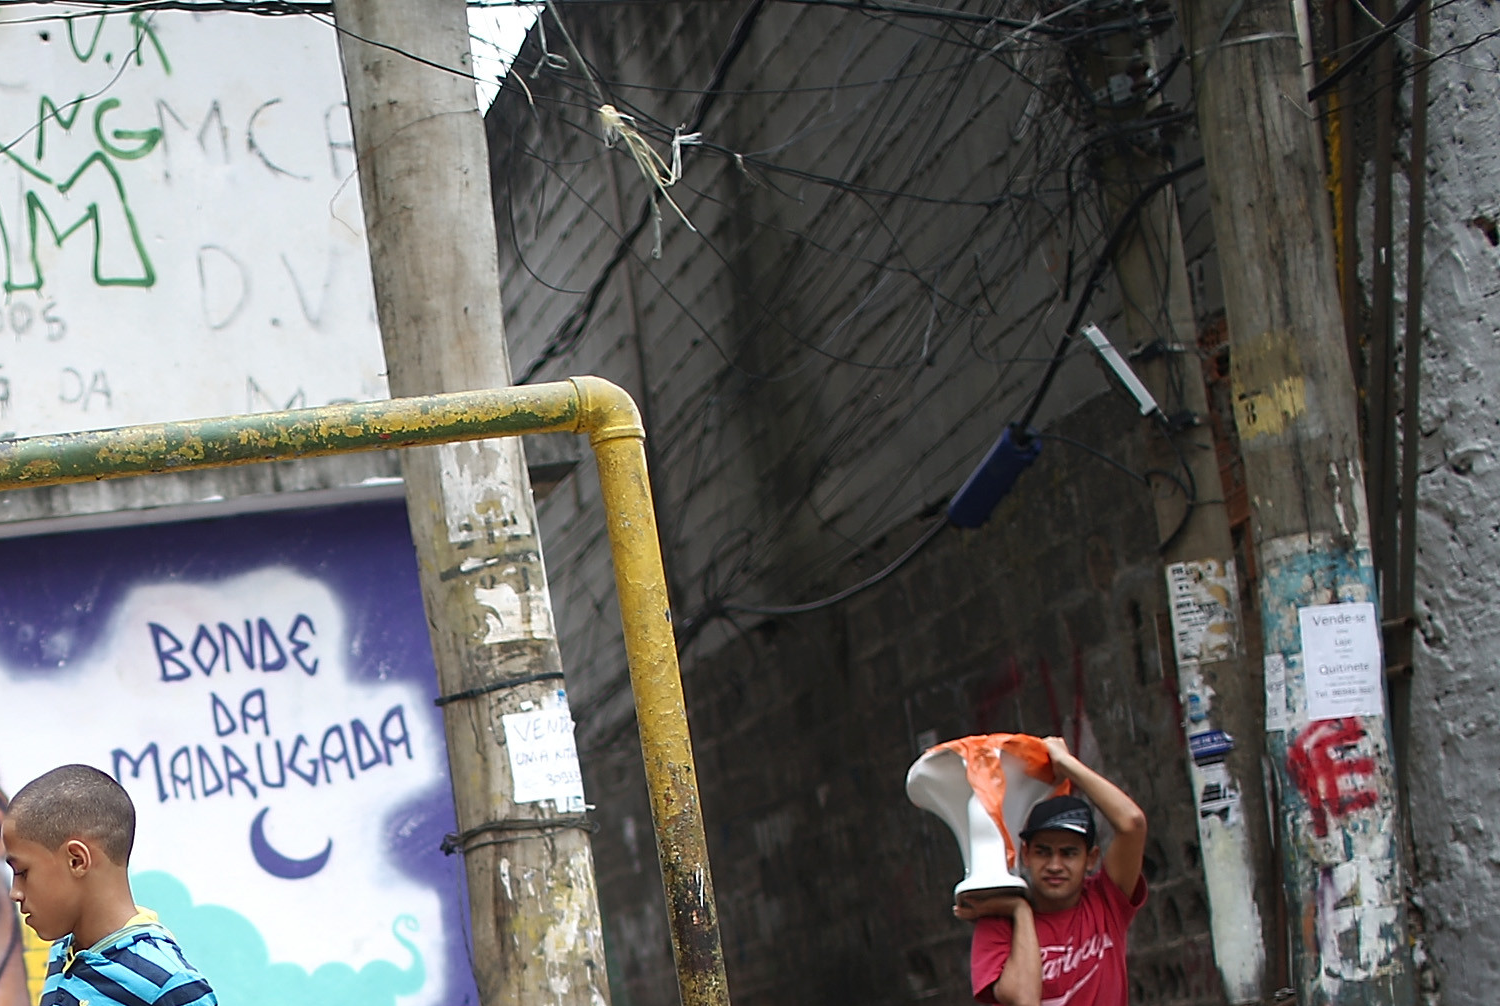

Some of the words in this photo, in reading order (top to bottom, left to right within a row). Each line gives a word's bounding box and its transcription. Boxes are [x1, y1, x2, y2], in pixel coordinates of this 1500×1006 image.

[147, 613, 320, 683] BONDE
[210, 687, 270, 738] DA
[110, 703, 414, 803] MADRUGADA
